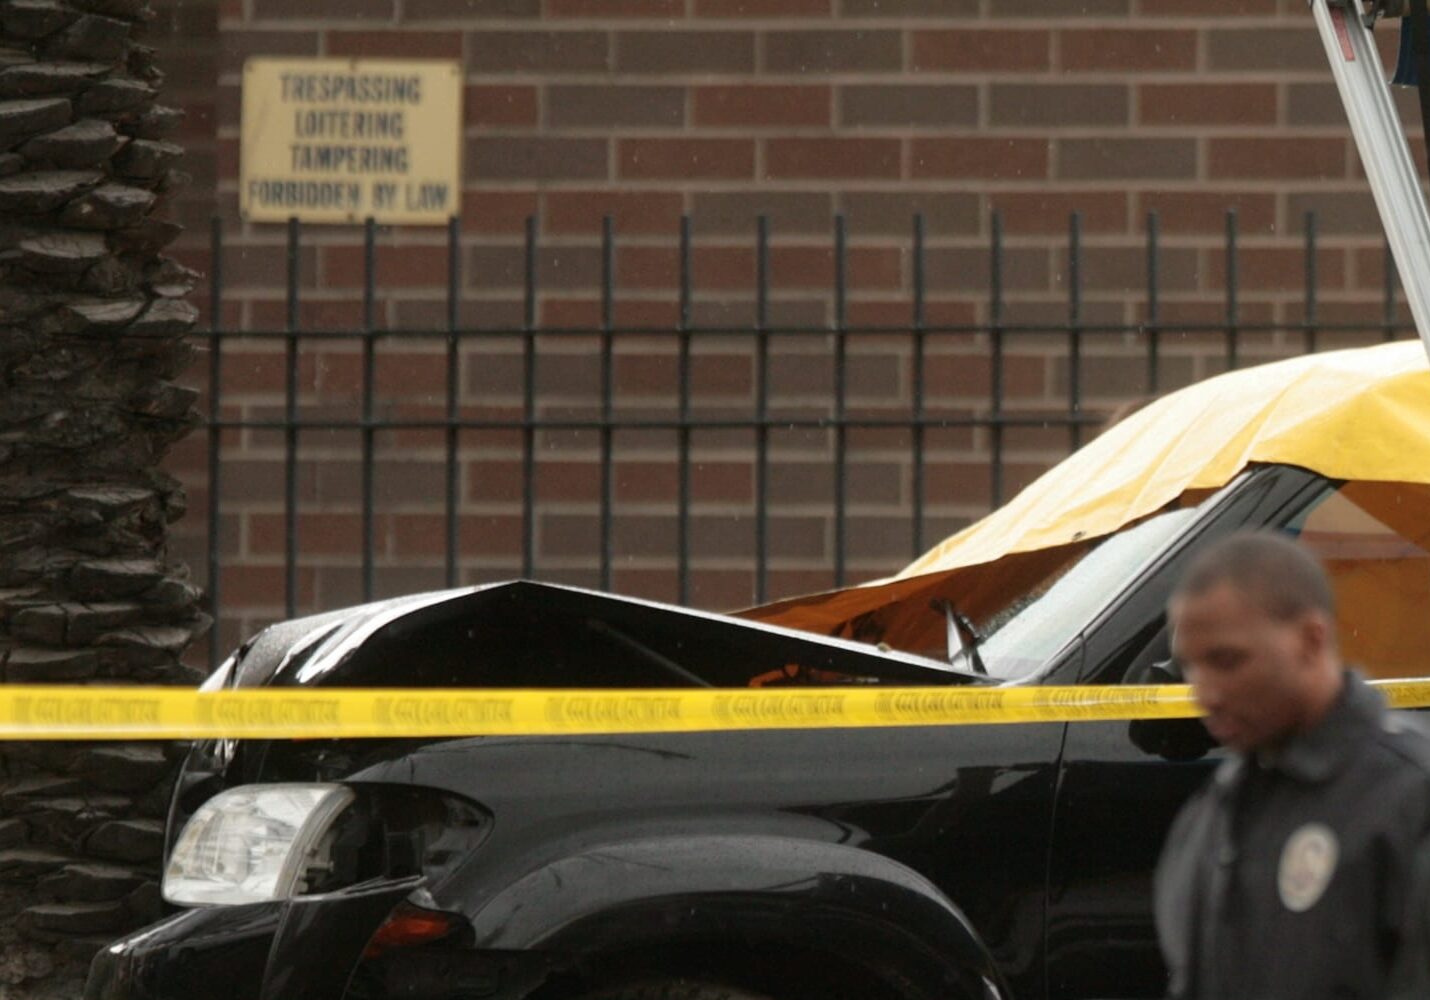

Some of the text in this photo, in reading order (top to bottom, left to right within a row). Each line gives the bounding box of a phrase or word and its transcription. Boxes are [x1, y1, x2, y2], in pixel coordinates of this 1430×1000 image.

[280, 74, 422, 103] TRESPASSING
[294, 110, 404, 139] LOITERING
[290, 146, 409, 173] TAMPERING
[249, 181, 449, 212] FORBIDDEN BY LAW
